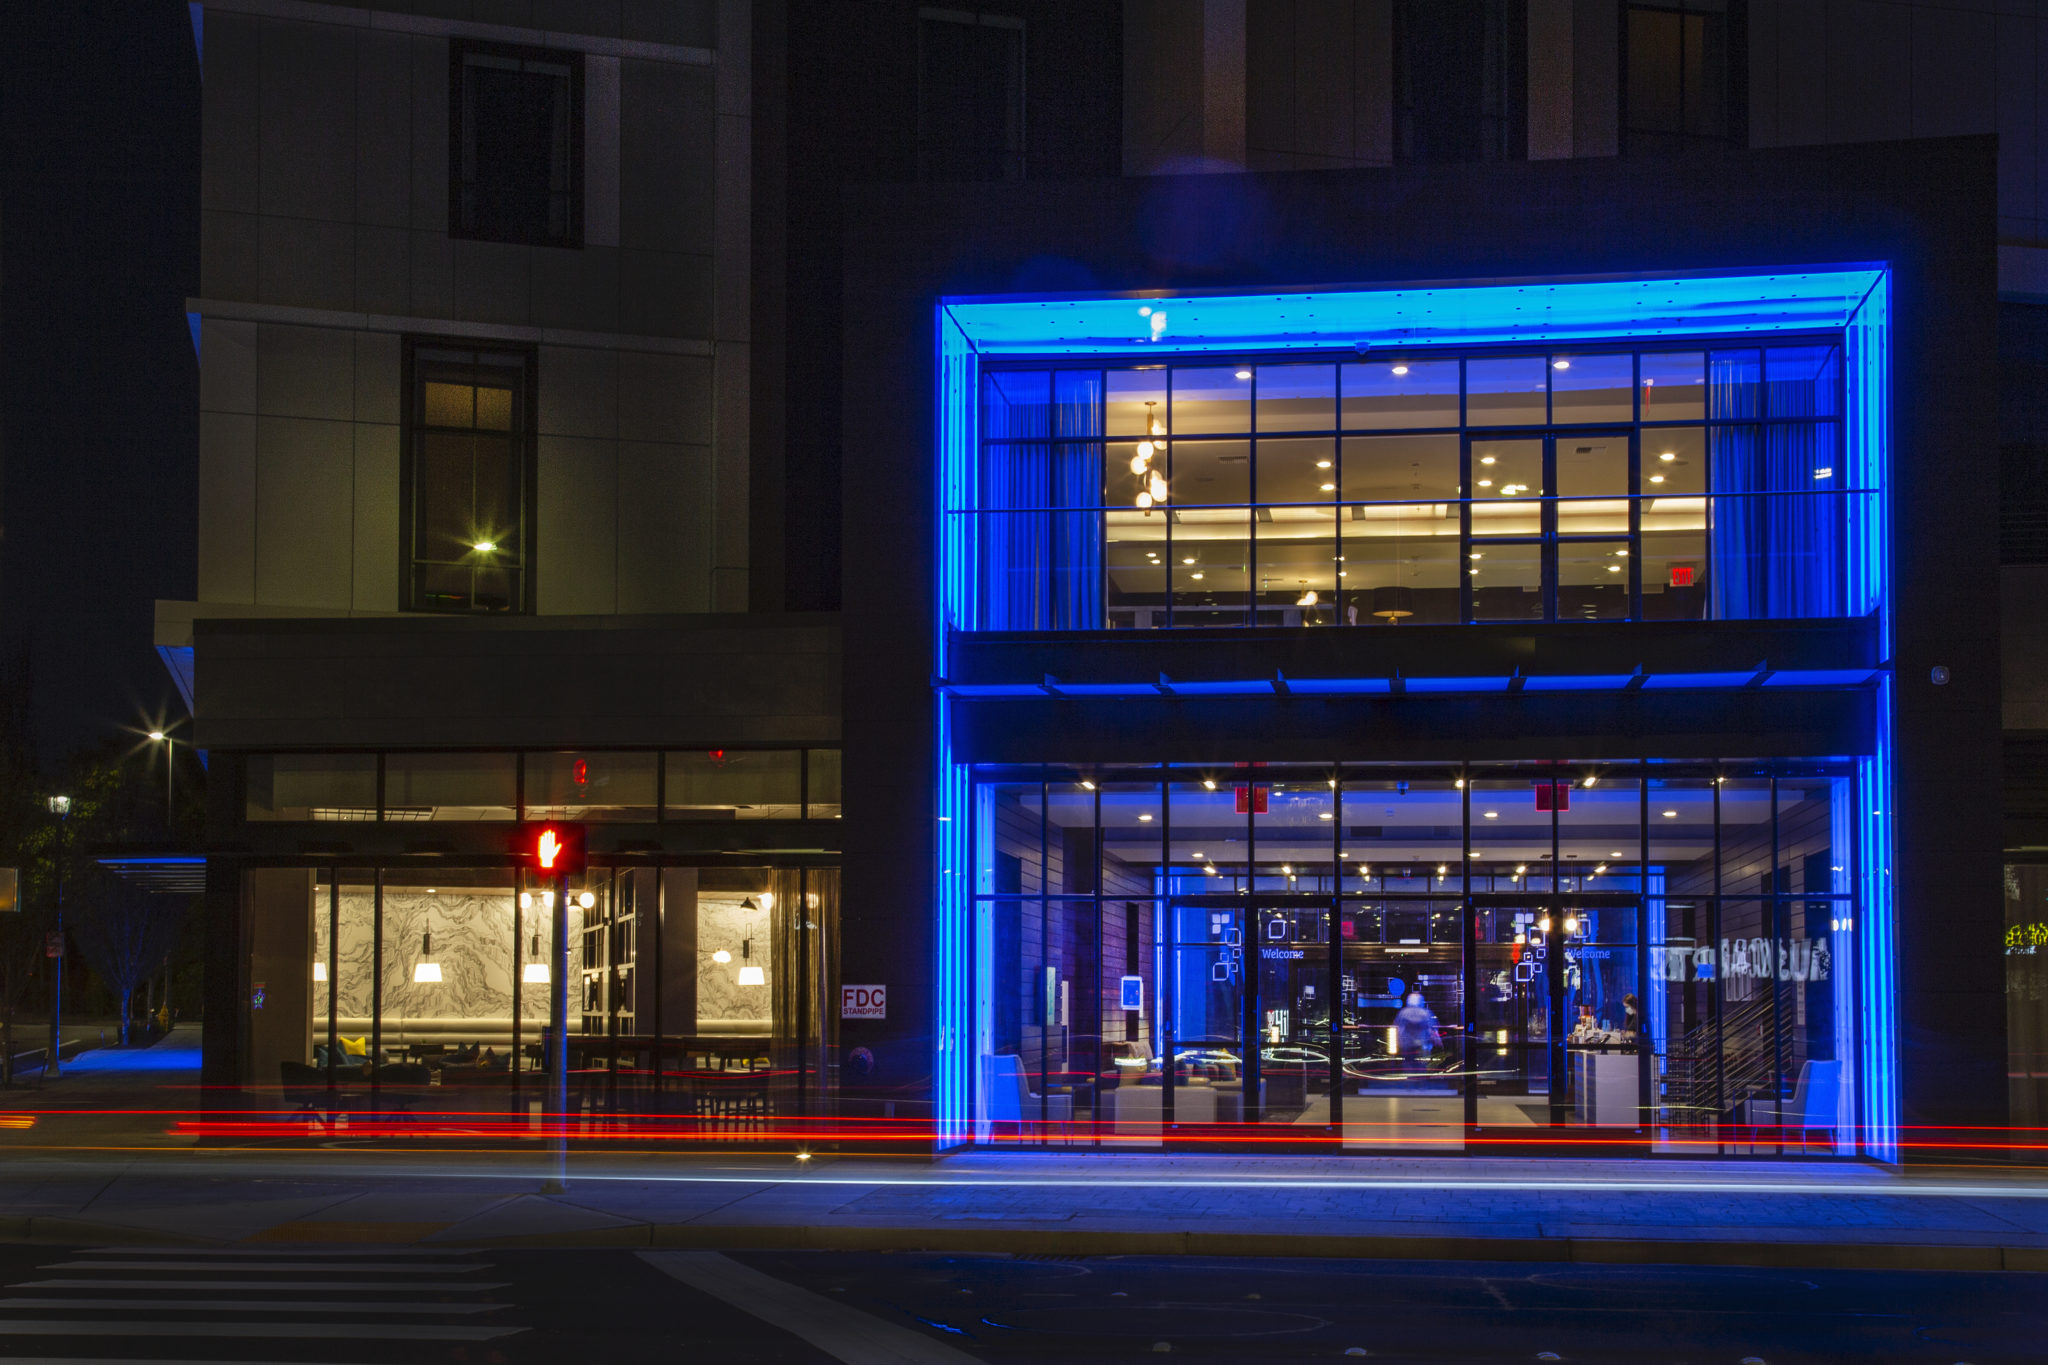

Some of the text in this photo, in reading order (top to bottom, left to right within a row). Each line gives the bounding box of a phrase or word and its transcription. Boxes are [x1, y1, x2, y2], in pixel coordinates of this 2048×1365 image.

[1672, 567, 1692, 585] EXIT
[1261, 947, 1304, 959] Welcome
[1566, 948, 1611, 959] Welcome
[843, 989, 884, 1007] FDC
[843, 1007, 884, 1015] STANDPIPE
